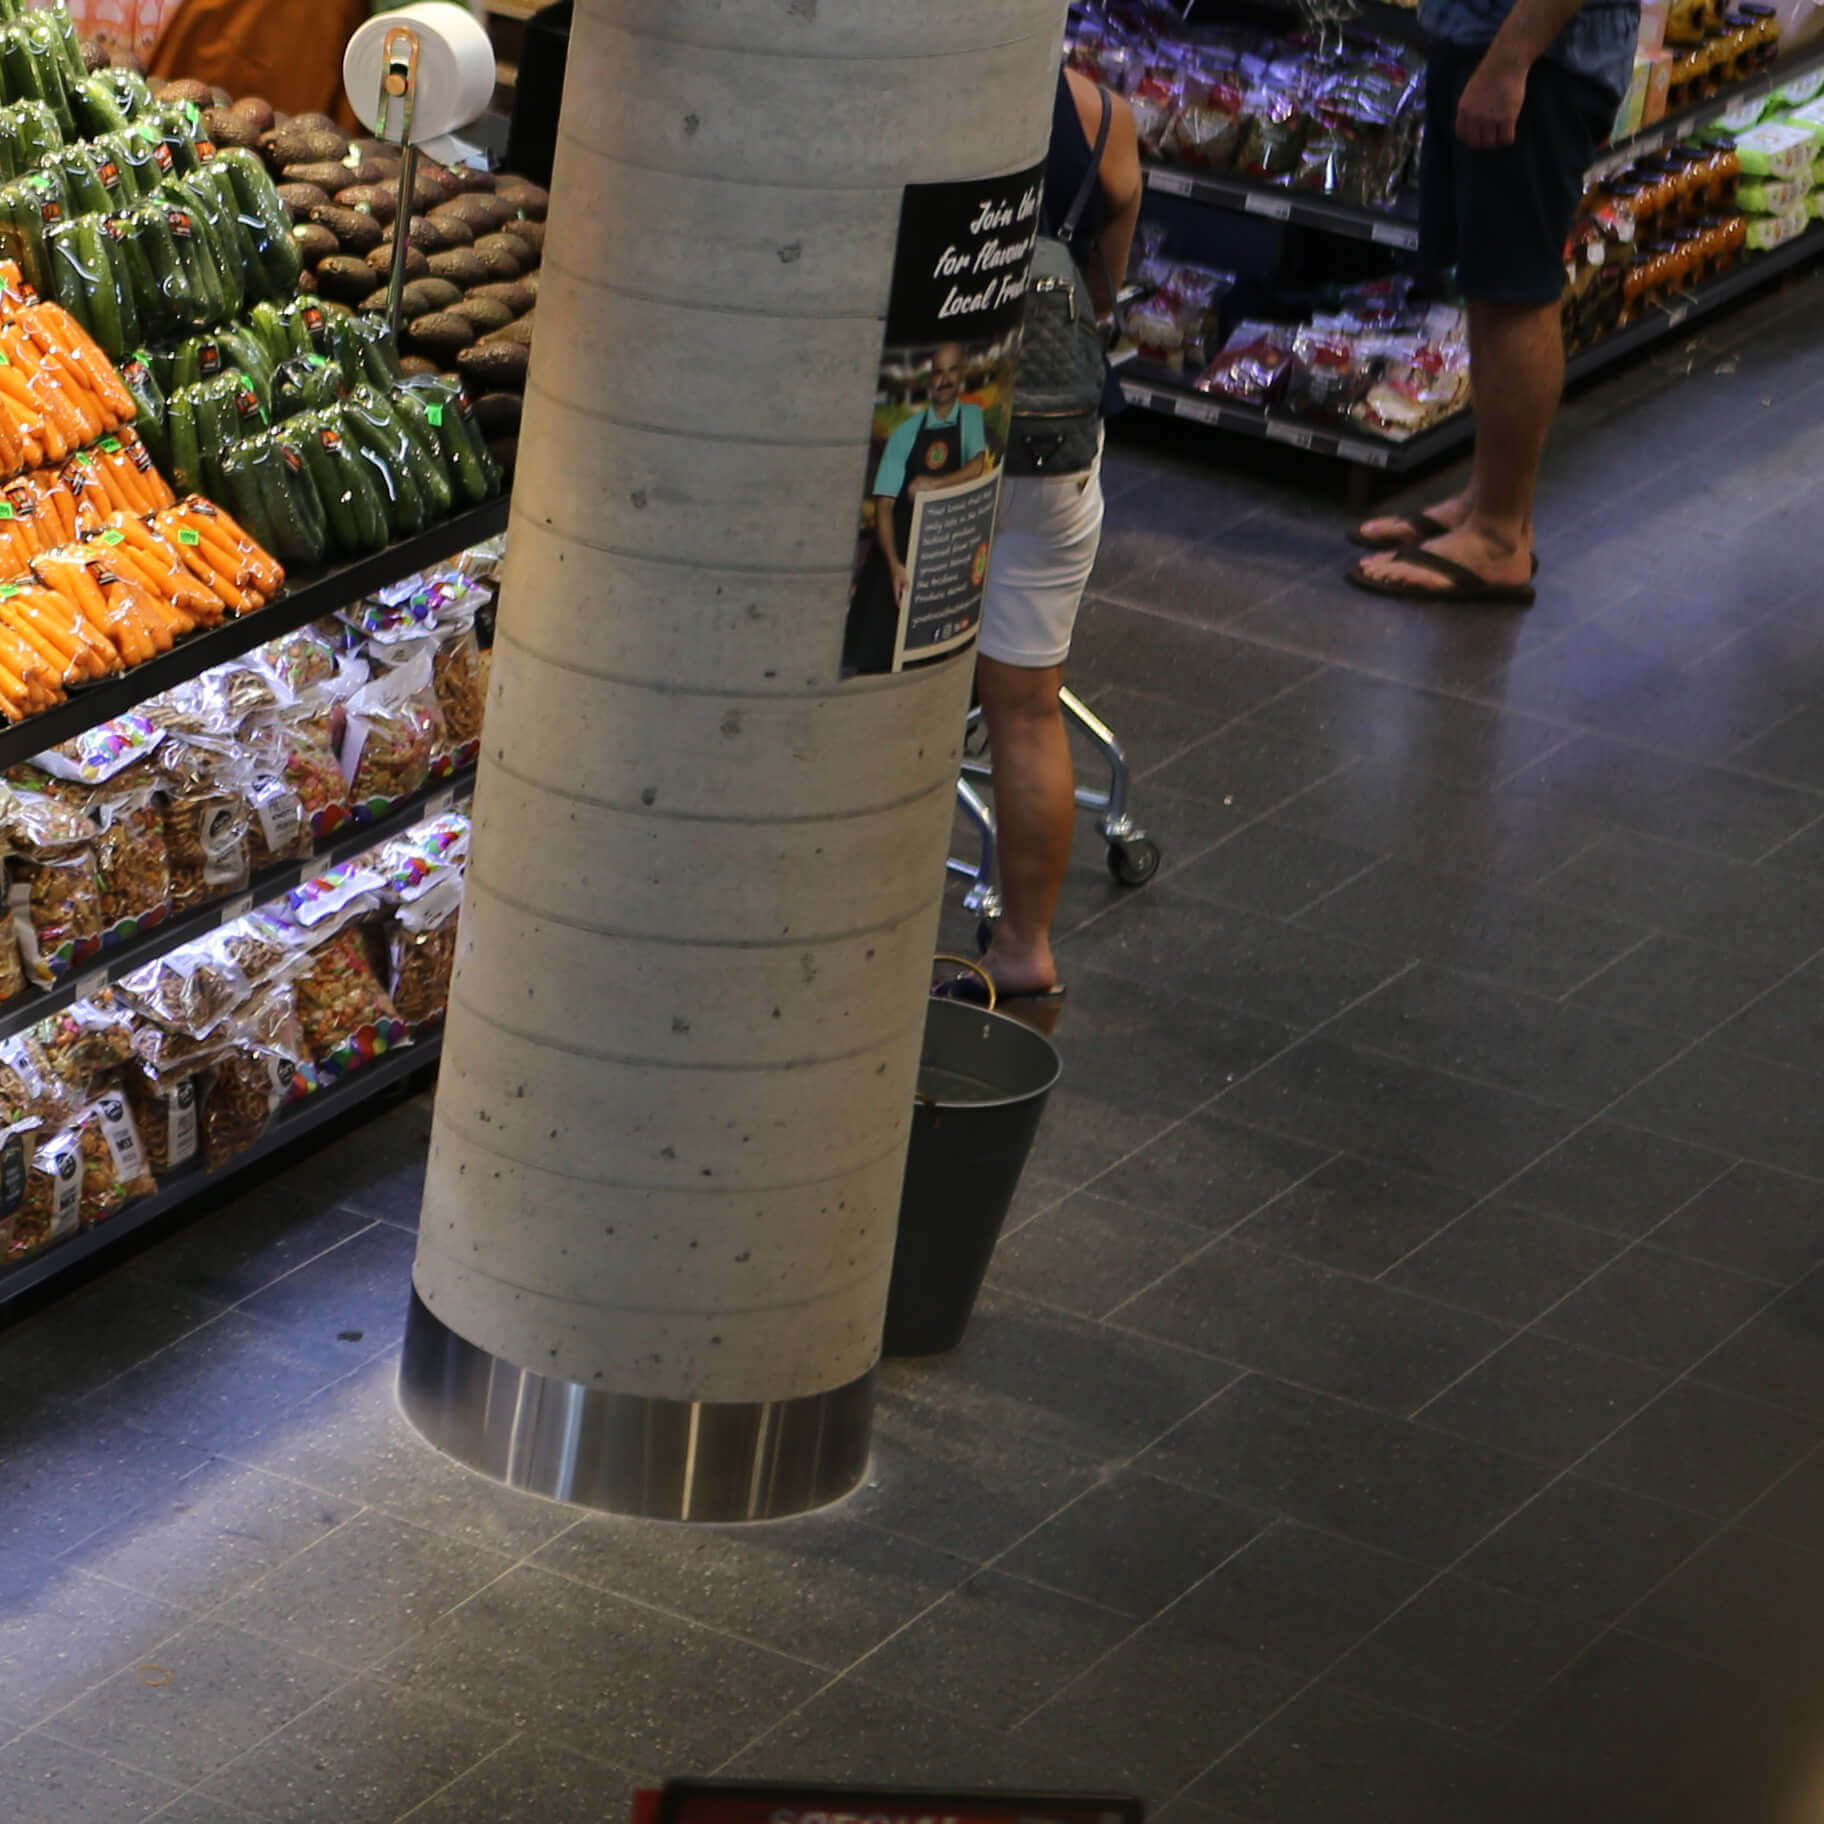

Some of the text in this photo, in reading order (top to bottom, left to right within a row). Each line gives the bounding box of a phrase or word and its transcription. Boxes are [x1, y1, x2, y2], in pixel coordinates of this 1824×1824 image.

[970, 198, 1014, 236] Join
[933, 243, 971, 280] for
[937, 276, 999, 320] Local
